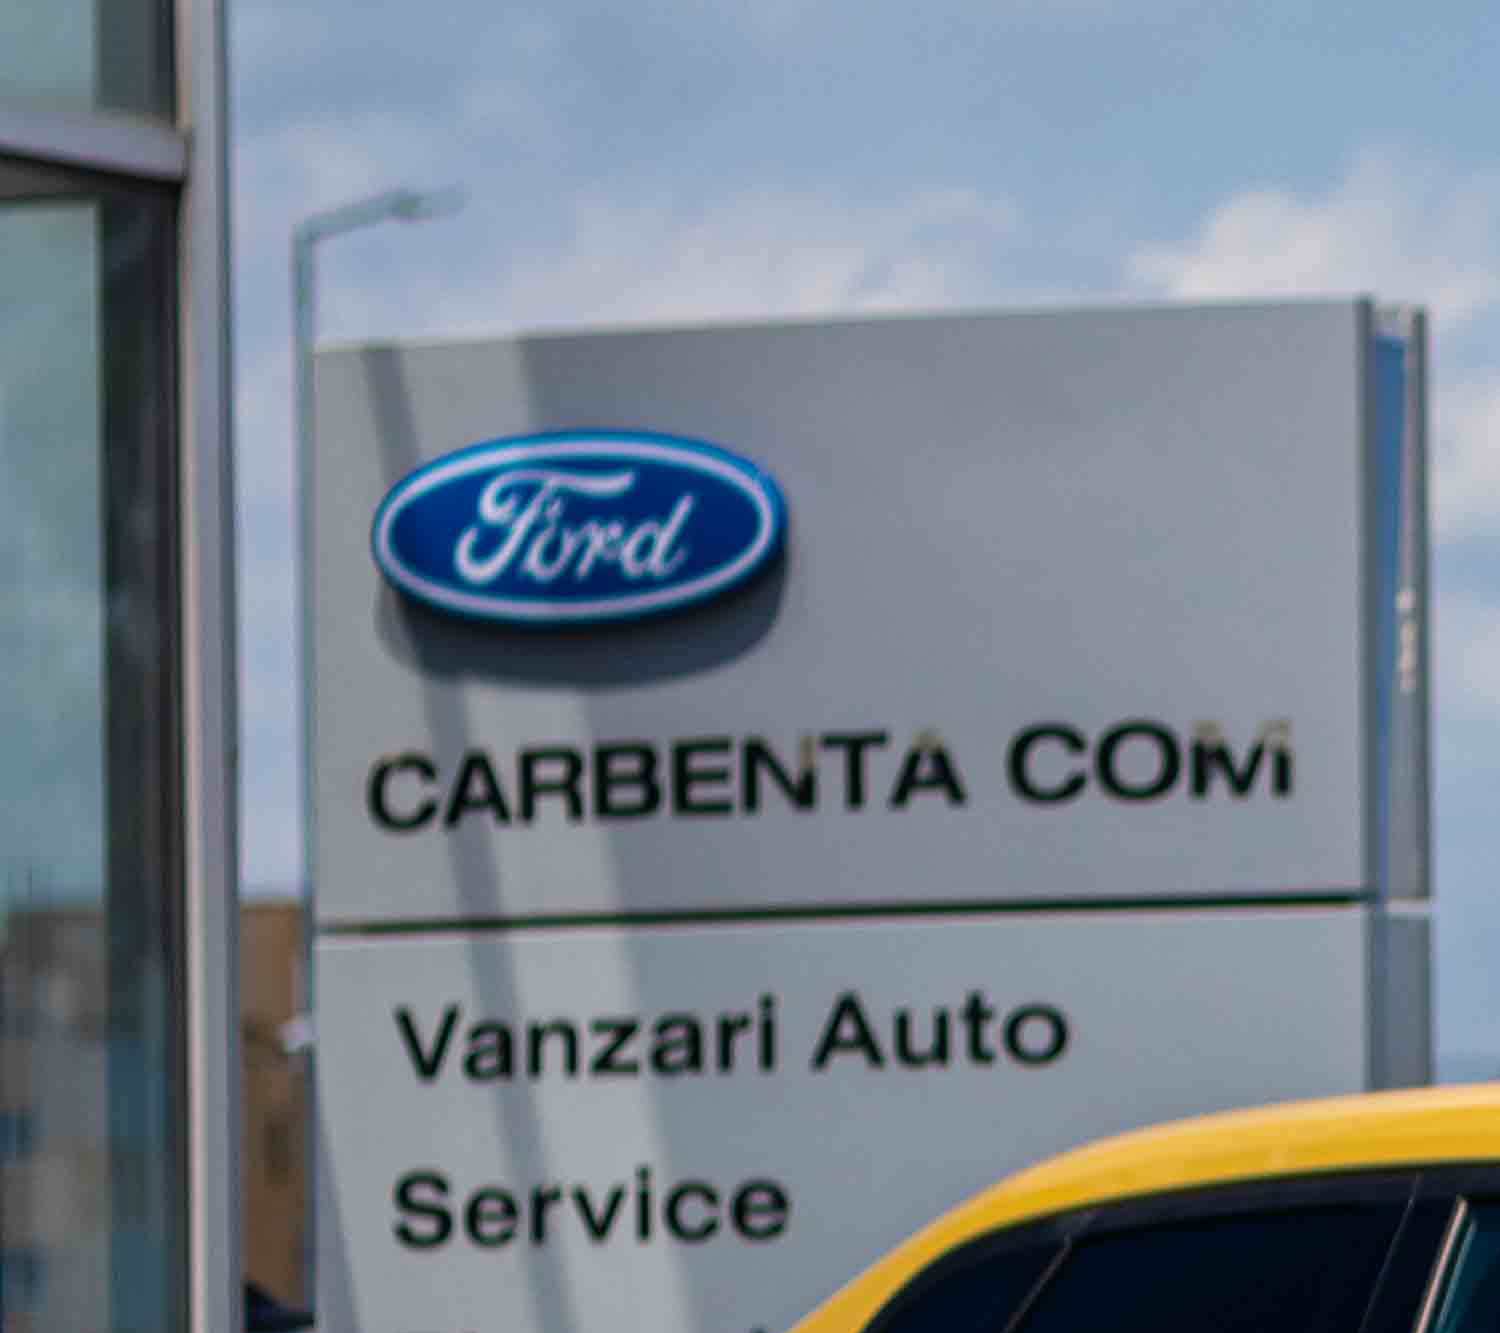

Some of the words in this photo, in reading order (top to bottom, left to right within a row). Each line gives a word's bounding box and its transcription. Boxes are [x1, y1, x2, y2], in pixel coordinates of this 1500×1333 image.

[453, 466, 694, 582] Ford
[366, 730, 968, 833] CARBENTA
[1005, 716, 1296, 804] COM
[396, 993, 779, 1084] Vanzari
[812, 990, 1071, 1072] Auto
[391, 1167, 792, 1252] Service
